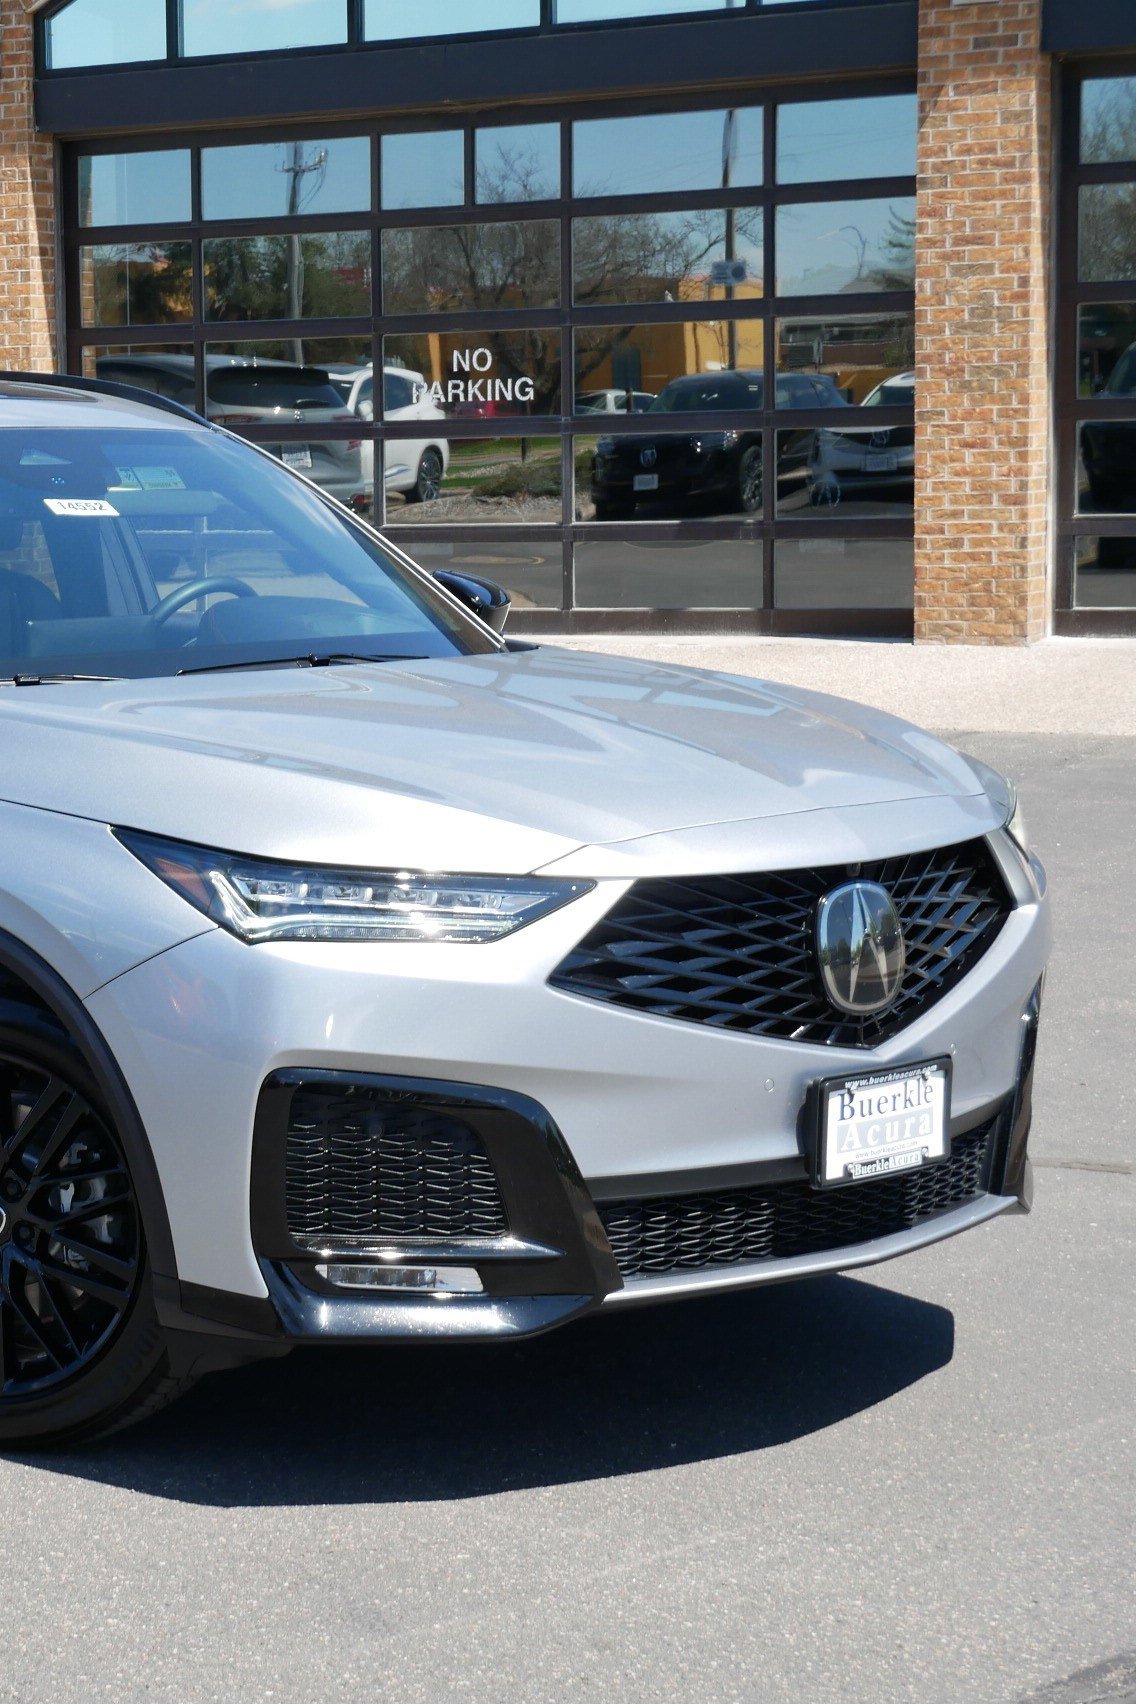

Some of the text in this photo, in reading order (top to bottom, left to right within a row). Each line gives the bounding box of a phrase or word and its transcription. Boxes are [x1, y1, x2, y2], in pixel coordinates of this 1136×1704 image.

[452, 347, 492, 372] NO
[412, 377, 534, 402] PARKING
[56, 501, 107, 511] 14552
[845, 1064, 938, 1089] www.buerkleacura.com
[837, 1079, 934, 1121] Buerkle
[840, 1112, 931, 1151] Acura
